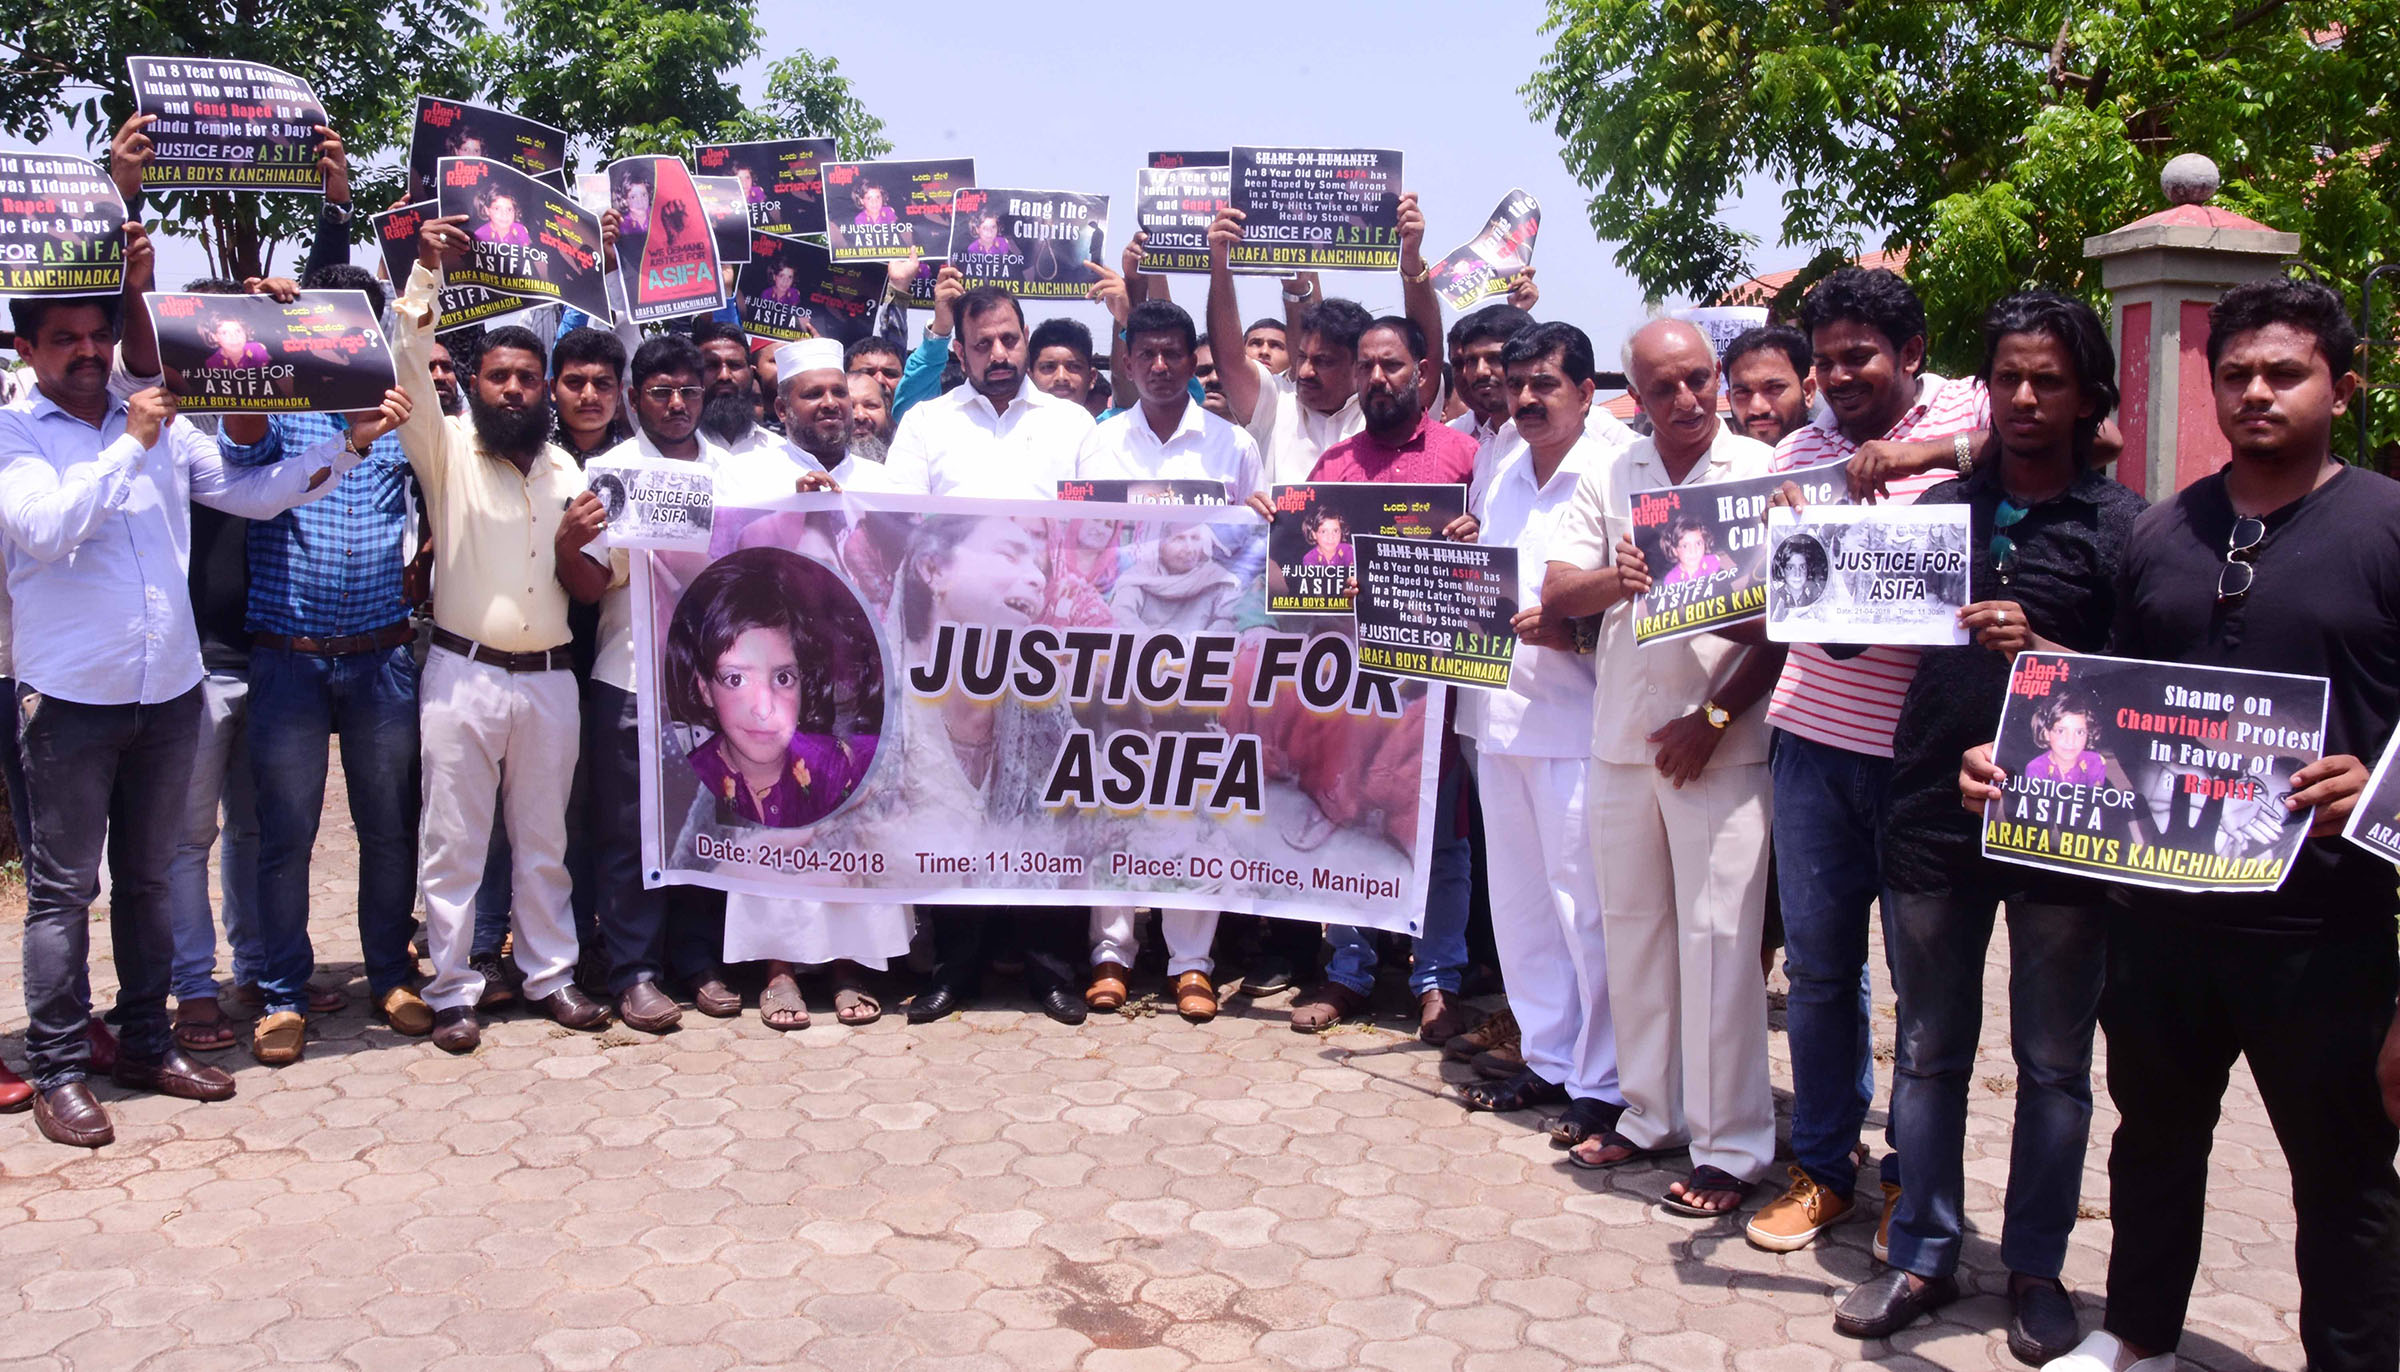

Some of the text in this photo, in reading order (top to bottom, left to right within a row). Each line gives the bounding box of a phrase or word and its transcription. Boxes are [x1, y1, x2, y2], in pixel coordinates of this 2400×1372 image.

[149, 64, 299, 88] An 8 Year Old Kashmiri
[144, 81, 187, 96] Infant
[191, 84, 220, 98] Who
[224, 87, 249, 98] was
[164, 102, 303, 119] and Gang Raped in a
[148, 119, 312, 138] Hindu Temple For 8 Days
[223, 145, 254, 158] FOR
[1256, 152, 1378, 166] SHAME ON HUMANITY
[24, 159, 97, 176] Kashmiri
[142, 167, 181, 181] ARAFA
[188, 167, 223, 181] BOYS
[1245, 168, 1387, 179] An 8 Year Old Girl ASIFA has
[1009, 199, 1087, 219] Hang the
[22, 219, 110, 234] For 8 Days
[840, 223, 913, 233] #JUSTICE FOR
[1014, 221, 1080, 241] Culprits
[1303, 228, 1332, 240] FOR
[1336, 227, 1397, 243] ASIFA
[855, 233, 900, 246] ASIFA
[43, 241, 120, 261] ASIFA
[523, 245, 549, 264] FOR
[952, 253, 1024, 264] #JUSTICE FOR
[1229, 248, 1397, 264] ARAFA BOYS KANCHINADKA
[475, 254, 532, 276] ASIFA
[966, 264, 1010, 277] ASIFA
[11, 269, 120, 287] KANCHINADKA
[450, 271, 478, 283] ARAFA
[480, 273, 499, 286] BOYS
[649, 262, 713, 290] ASIFA
[261, 365, 295, 378] FOR
[206, 380, 274, 395] ASIFA
[630, 489, 709, 506] JUSTICE FOR
[1285, 487, 1315, 501] Don't
[1640, 492, 1680, 510] Don't
[1277, 497, 1305, 513] Rape
[651, 509, 687, 523] ASIFA
[1632, 507, 1668, 527] Rape
[1377, 543, 1489, 565] SHAME ON HUMANITY
[1835, 552, 1960, 572] JUSTICE FOR
[1282, 565, 1344, 578] #JUSTICE
[1369, 561, 1500, 582] An 8 Year Old Girl ASIFA has
[1369, 573, 1500, 594] been Raped by Some Morons
[1870, 580, 1925, 600] ASIFA
[1273, 597, 1325, 608] ARAFA BOYS
[1372, 585, 1381, 594] in
[1392, 586, 1424, 599] Temple
[1428, 589, 1452, 601] Later
[1455, 591, 1476, 605] They
[1480, 594, 1496, 606] Kill
[1656, 587, 1713, 613] ASIFA
[1373, 598, 1495, 618] Her By Hitts Twise on Her
[1636, 597, 1725, 637] ARAFA BOYS
[1400, 612, 1468, 628] Head by Stone
[1360, 624, 1512, 657] #JUSTICE FOR ASIFA
[910, 625, 1402, 715] JUSTICE FOR
[1359, 647, 1507, 681] ARAFA BOYS KANCHINADKA
[2024, 657, 2070, 682] Don't
[2010, 670, 2050, 700] Rape
[2165, 685, 2272, 716] Shame on
[2117, 708, 2320, 752] Chauvinist Protest
[2150, 740, 2274, 775] in Favor of
[1045, 732, 1263, 811] ASIFA
[1999, 775, 2135, 810] #JUSTICE FOR
[2163, 774, 2255, 802] a Rapist
[2016, 796, 2102, 830] ASIFA
[1986, 821, 2284, 879] ARAFA BOYS KANCHINADKA
[699, 835, 1400, 899] Date: 21-04-2018 Time: 11.30am Place: DC Office, Manipal
